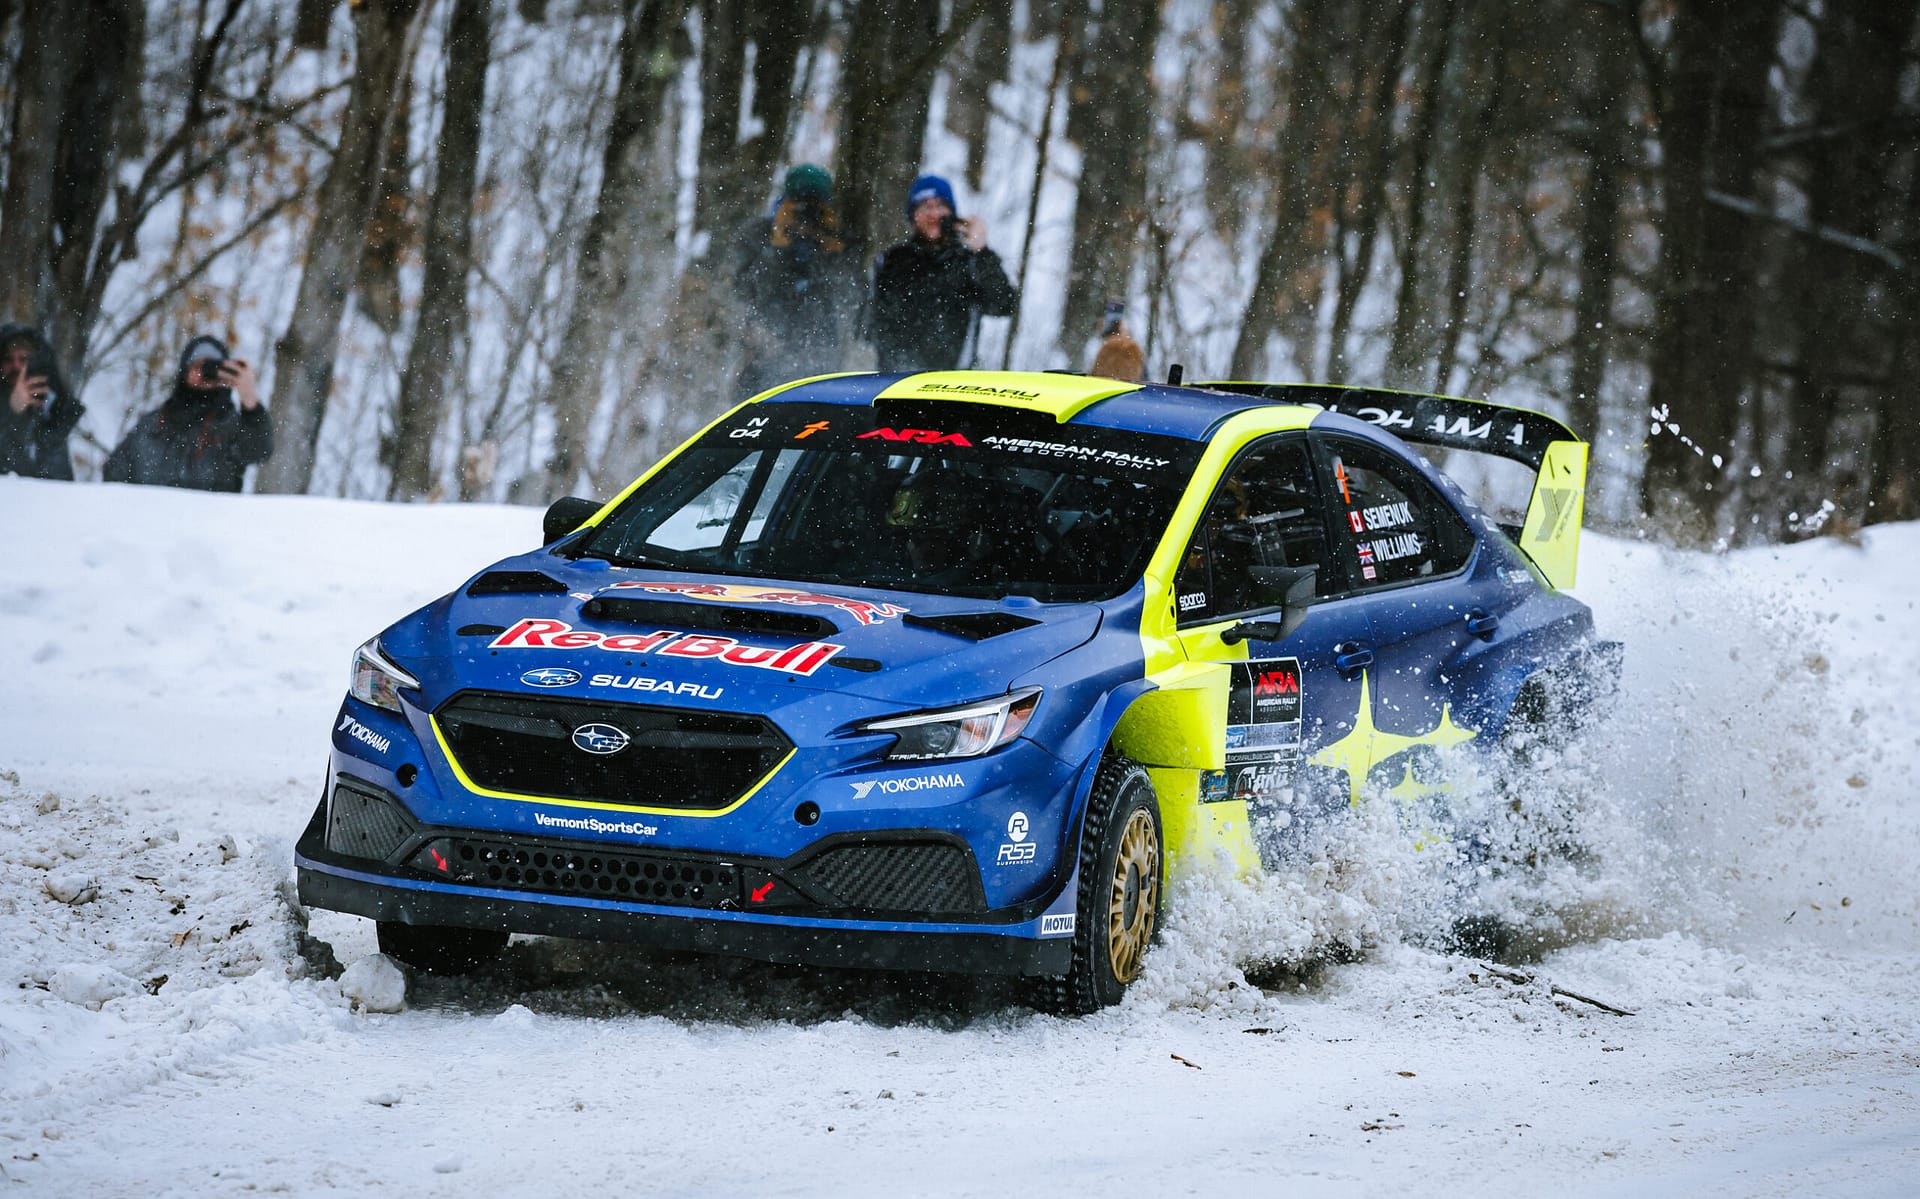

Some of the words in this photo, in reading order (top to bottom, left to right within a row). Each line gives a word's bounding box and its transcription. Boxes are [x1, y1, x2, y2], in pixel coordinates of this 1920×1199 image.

[921, 384, 1040, 398] SUBARU
[747, 417, 769, 427] N
[855, 427, 973, 447] ARA
[982, 436, 1098, 456] AMERICAN
[1101, 450, 1170, 466] RALLY
[991, 444, 1147, 470] ASSOCIATION
[1363, 501, 1414, 530] SEMENUK
[1371, 533, 1422, 562] WILLIAMS
[1179, 592, 1206, 608] sparco
[488, 618, 682, 654] Red
[656, 633, 845, 676] Bull
[589, 674, 724, 699] SUBARU
[1254, 671, 1299, 696] ARA
[1256, 698, 1281, 707] AMERICAN
[1282, 697, 1297, 706] RALLY
[348, 721, 390, 754] YOKOHAMA
[877, 773, 965, 794] YOKOHAMA
[534, 813, 657, 836] VermontSportsCar
[996, 842, 1036, 860] R53
[1043, 916, 1074, 932] MOTUL
